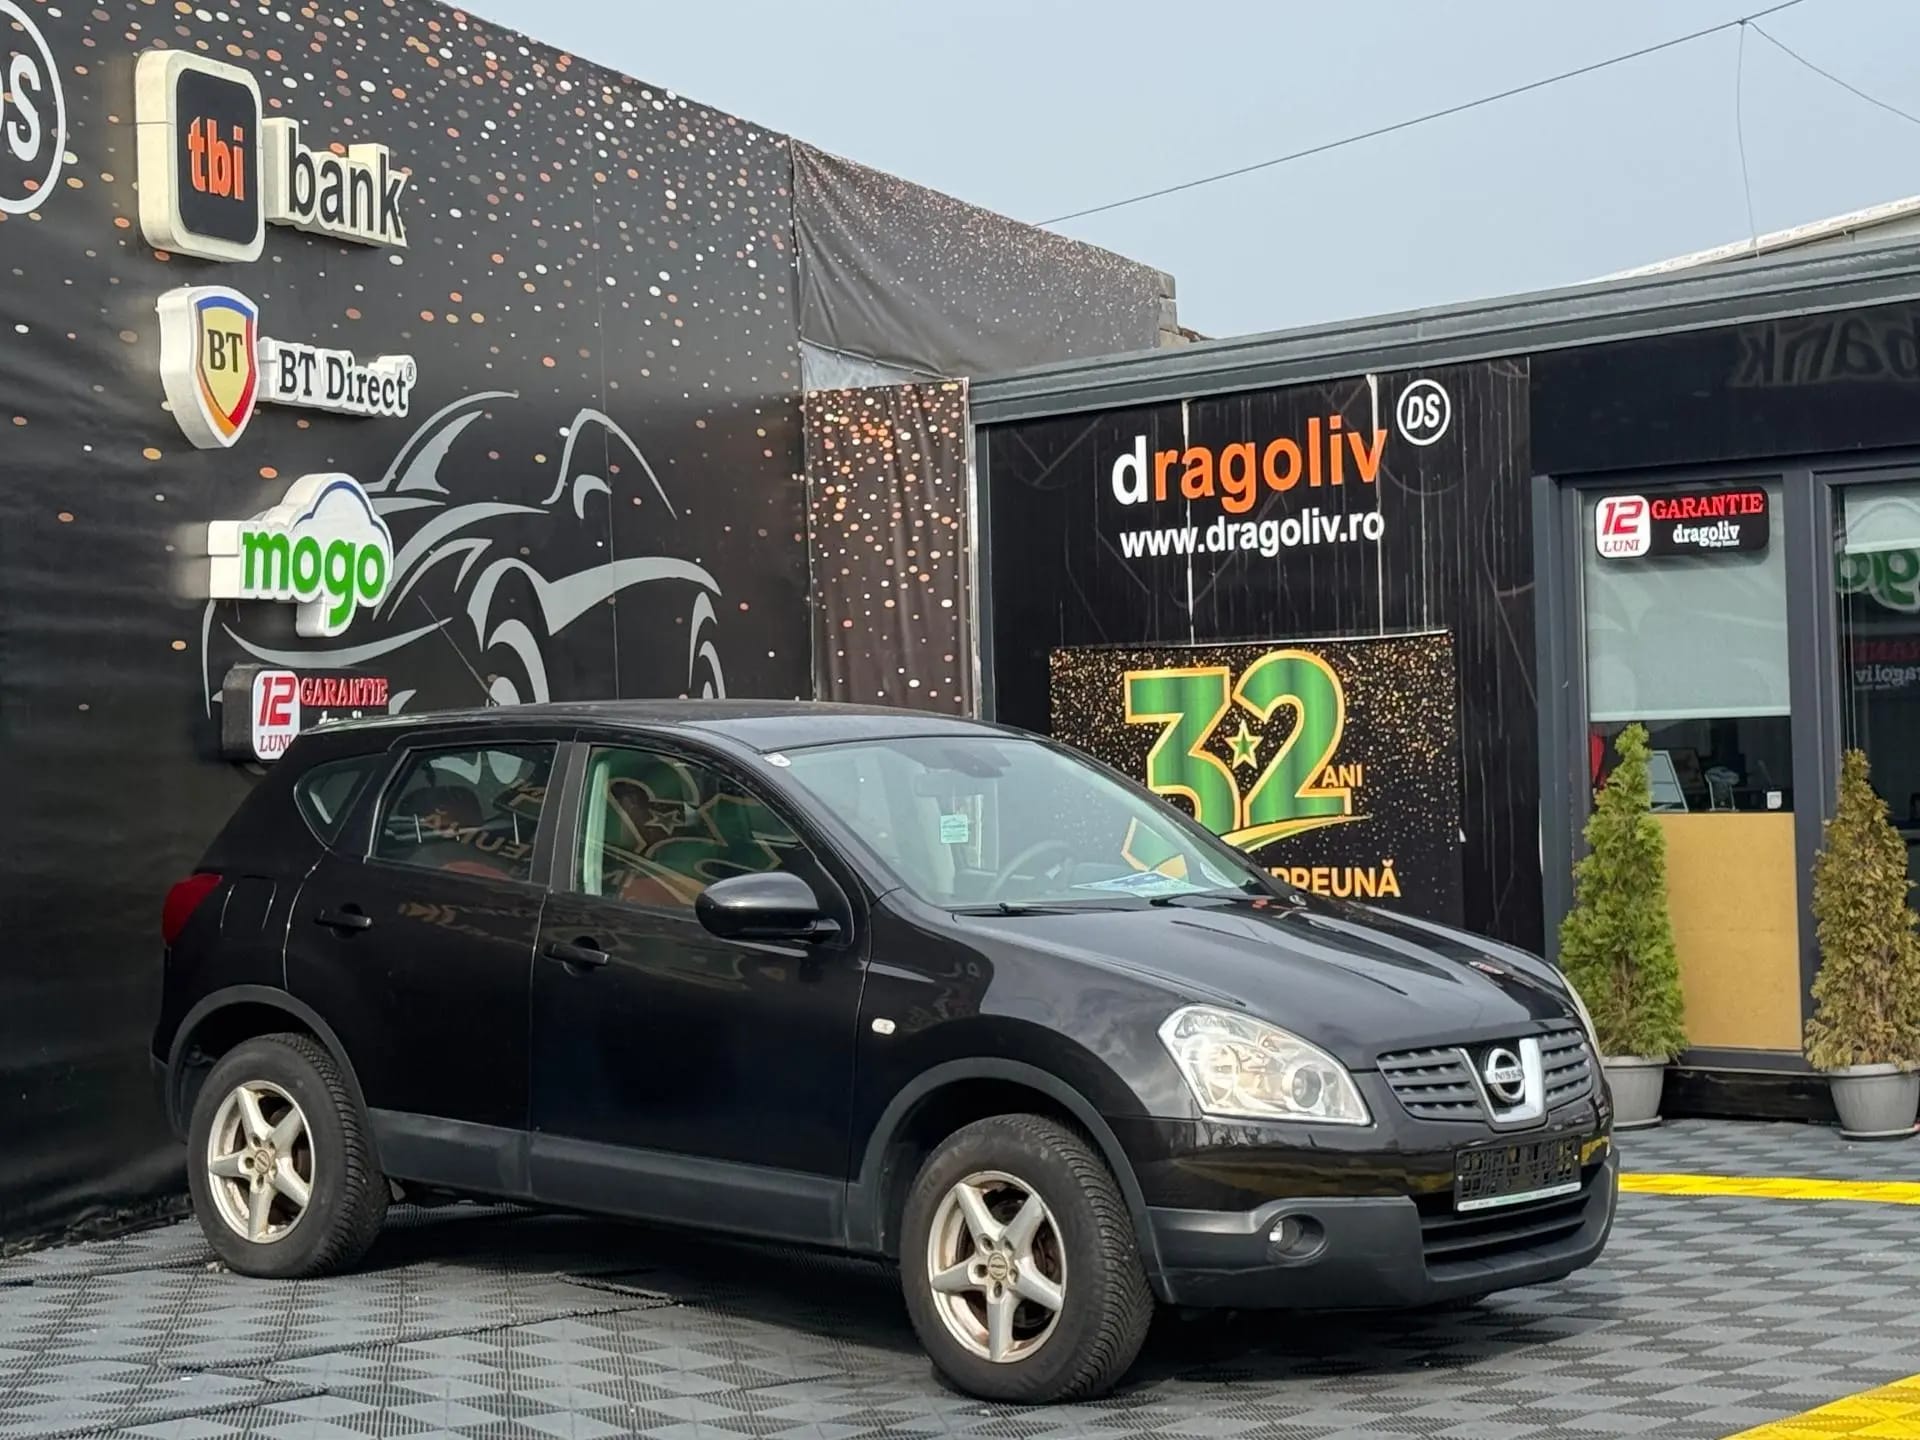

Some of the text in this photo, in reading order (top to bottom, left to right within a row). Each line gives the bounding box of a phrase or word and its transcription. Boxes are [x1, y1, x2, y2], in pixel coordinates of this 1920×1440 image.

[0, 54, 41, 161] S
[187, 116, 245, 201] tbi
[289, 127, 403, 240] bank
[207, 329, 242, 373] BT
[279, 349, 316, 396] BT
[1406, 395, 1441, 430] DS
[1111, 415, 1388, 513] dragoliv
[1603, 501, 1643, 535] 12
[1651, 493, 1765, 520] GARANTIE
[1120, 507, 1386, 559] www.dragoliv.ro
[1603, 540, 1640, 553] LUNI
[1672, 520, 1740, 547] dragoliv
[242, 531, 386, 627] mogo
[259, 677, 297, 726] 12
[301, 677, 389, 707] GARANTIE
[1124, 649, 1351, 834] 32
[1321, 763, 1363, 787] ANI
[1264, 858, 1401, 897] REUNĂ
